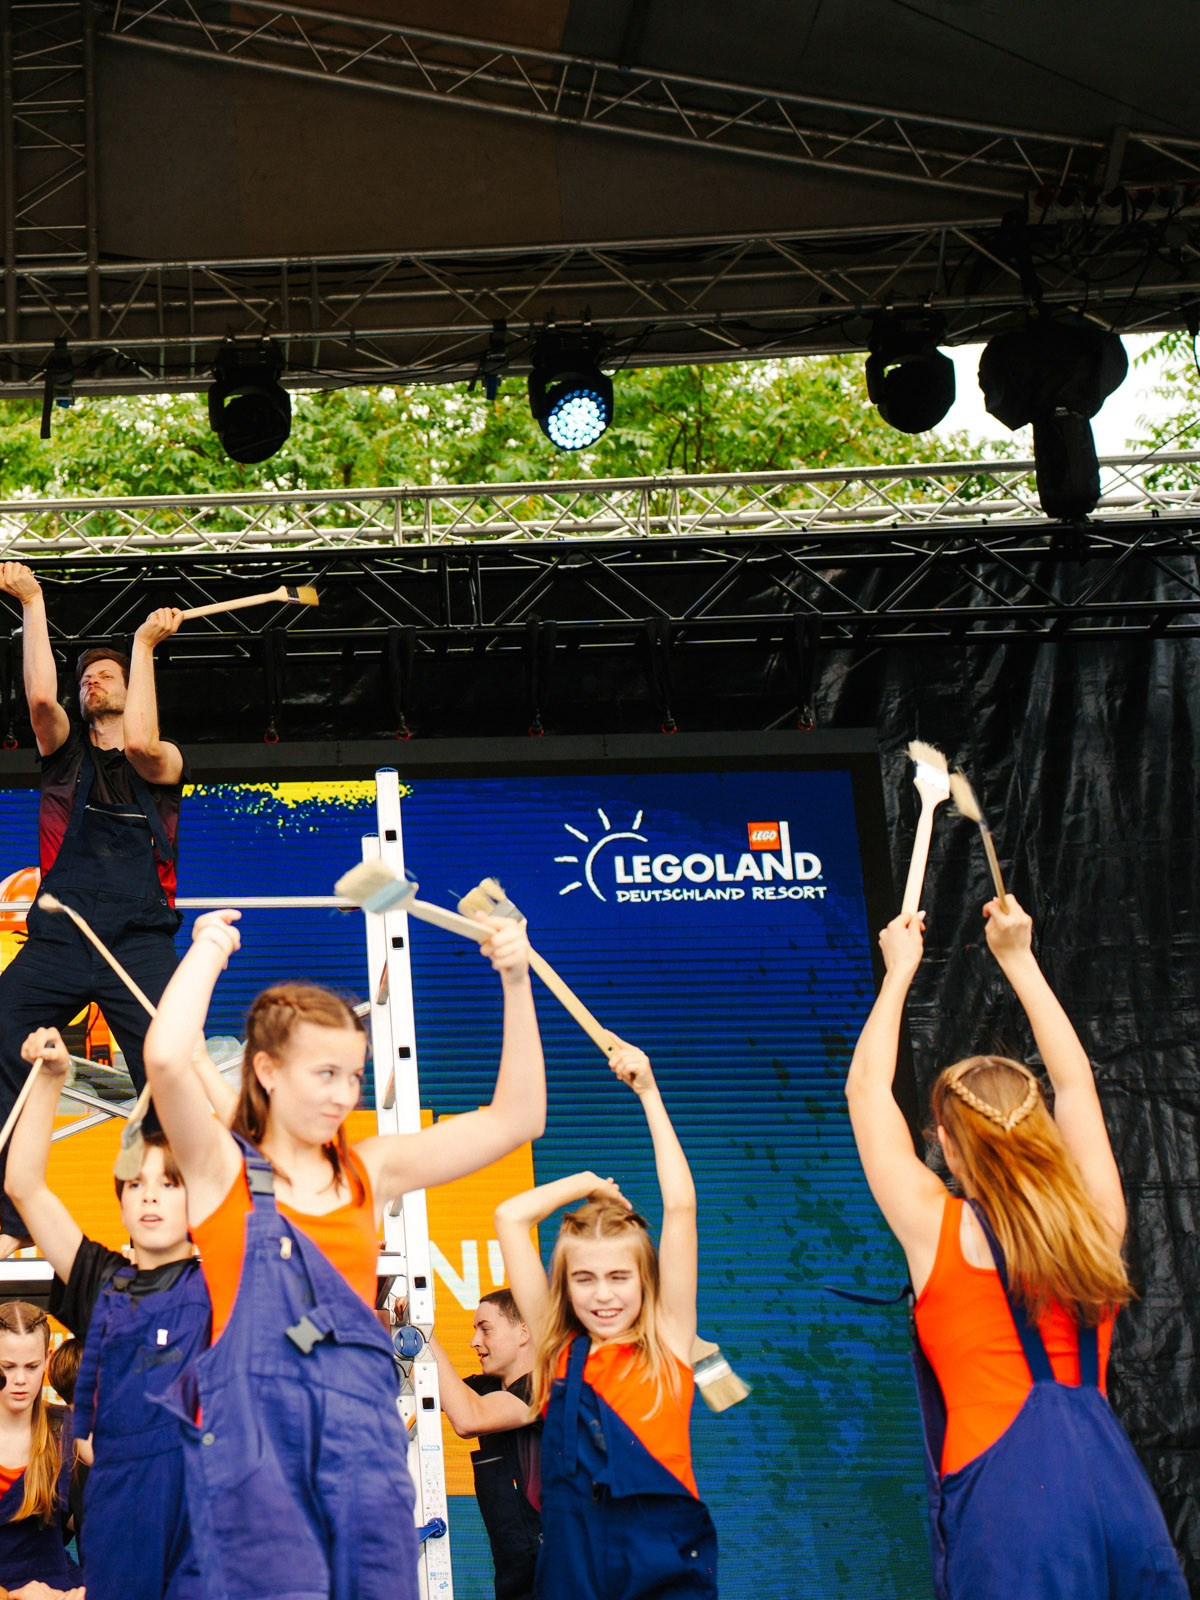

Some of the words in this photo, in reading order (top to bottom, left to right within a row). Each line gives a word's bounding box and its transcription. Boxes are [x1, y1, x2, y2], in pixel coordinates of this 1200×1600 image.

[752, 830, 777, 841] LEGO
[614, 821, 822, 883] LEGOLAND
[616, 887, 745, 902] DEUTSCHLAND
[752, 885, 827, 900] RESORT
